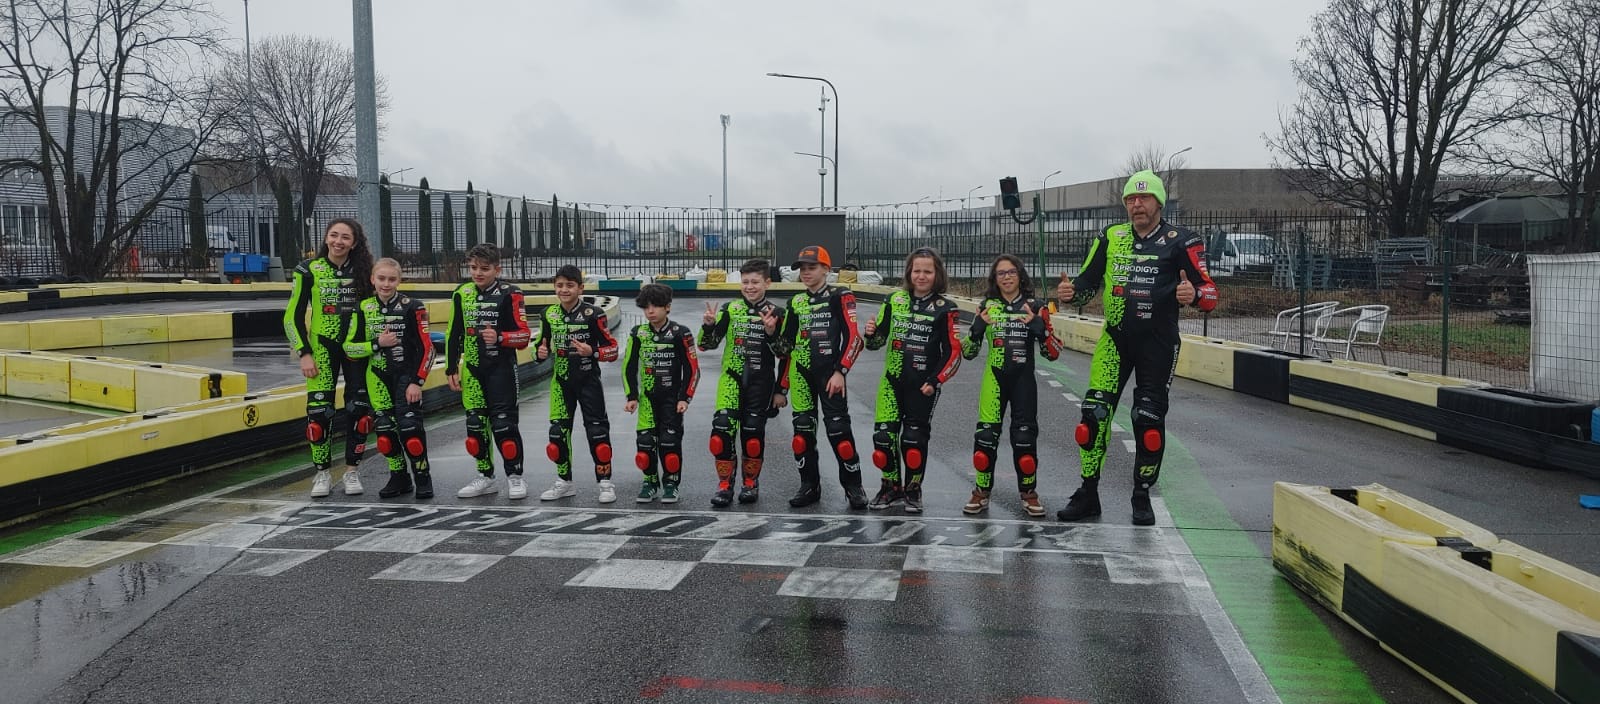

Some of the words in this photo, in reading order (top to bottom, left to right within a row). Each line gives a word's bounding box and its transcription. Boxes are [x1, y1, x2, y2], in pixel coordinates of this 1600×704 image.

[1119, 265, 1159, 274] PRODIGYS
[898, 320, 933, 332] PRODIGYS
[721, 515, 1081, 551] PARK
